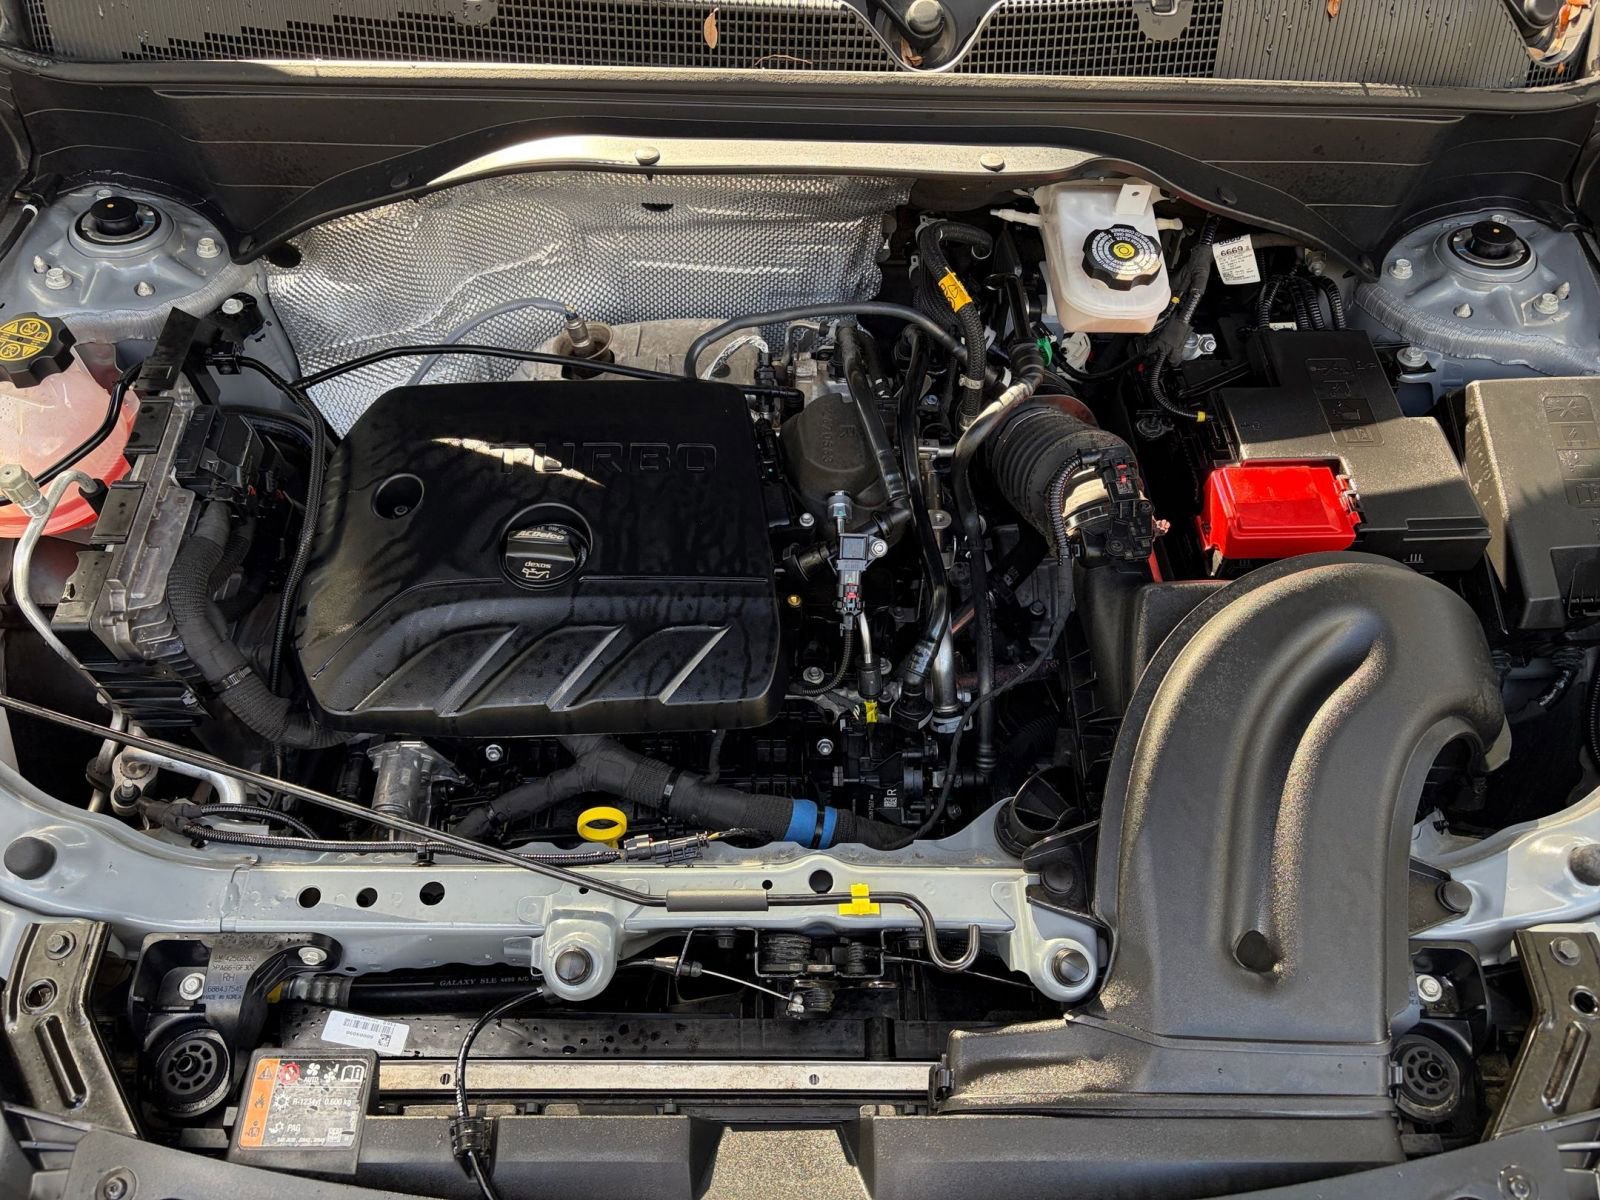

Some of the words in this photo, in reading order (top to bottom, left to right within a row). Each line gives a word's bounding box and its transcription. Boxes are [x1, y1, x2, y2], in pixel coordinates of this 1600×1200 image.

[1220, 245, 1244, 257] 6669
[490, 442, 717, 475] TURBO
[515, 530, 565, 540] ACDelco
[524, 560, 552, 569] dexos
[886, 788, 897, 796] R
[223, 972, 236, 981] RH
[480, 977, 498, 985] SLE
[287, 1123, 301, 1132] PAG
